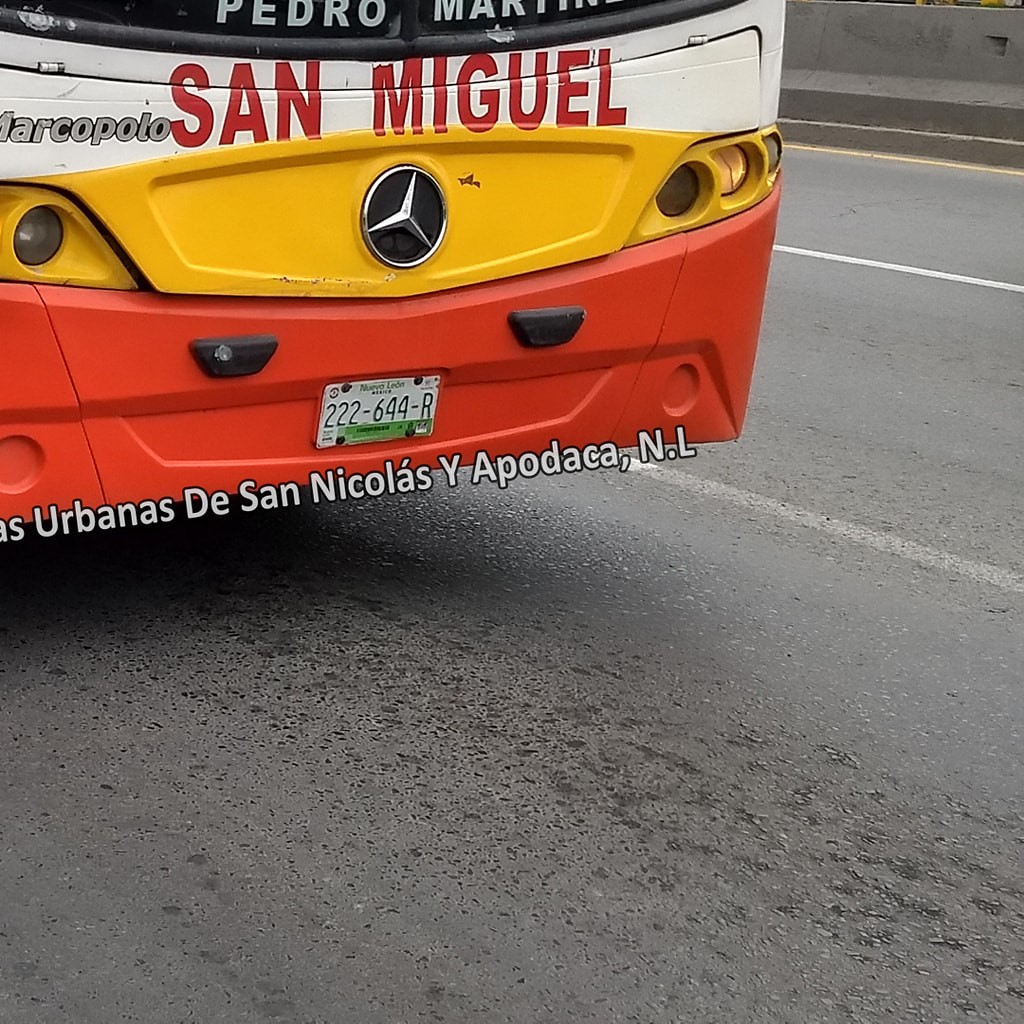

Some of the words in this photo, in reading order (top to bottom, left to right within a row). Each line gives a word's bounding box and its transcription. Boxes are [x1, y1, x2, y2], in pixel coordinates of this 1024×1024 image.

[169, 59, 323, 148] SAN
[371, 48, 628, 137] MIGUEL
[359, 384, 385, 393] Nuevo
[387, 380, 406, 390] León
[323, 392, 434, 428] 222-644-R
